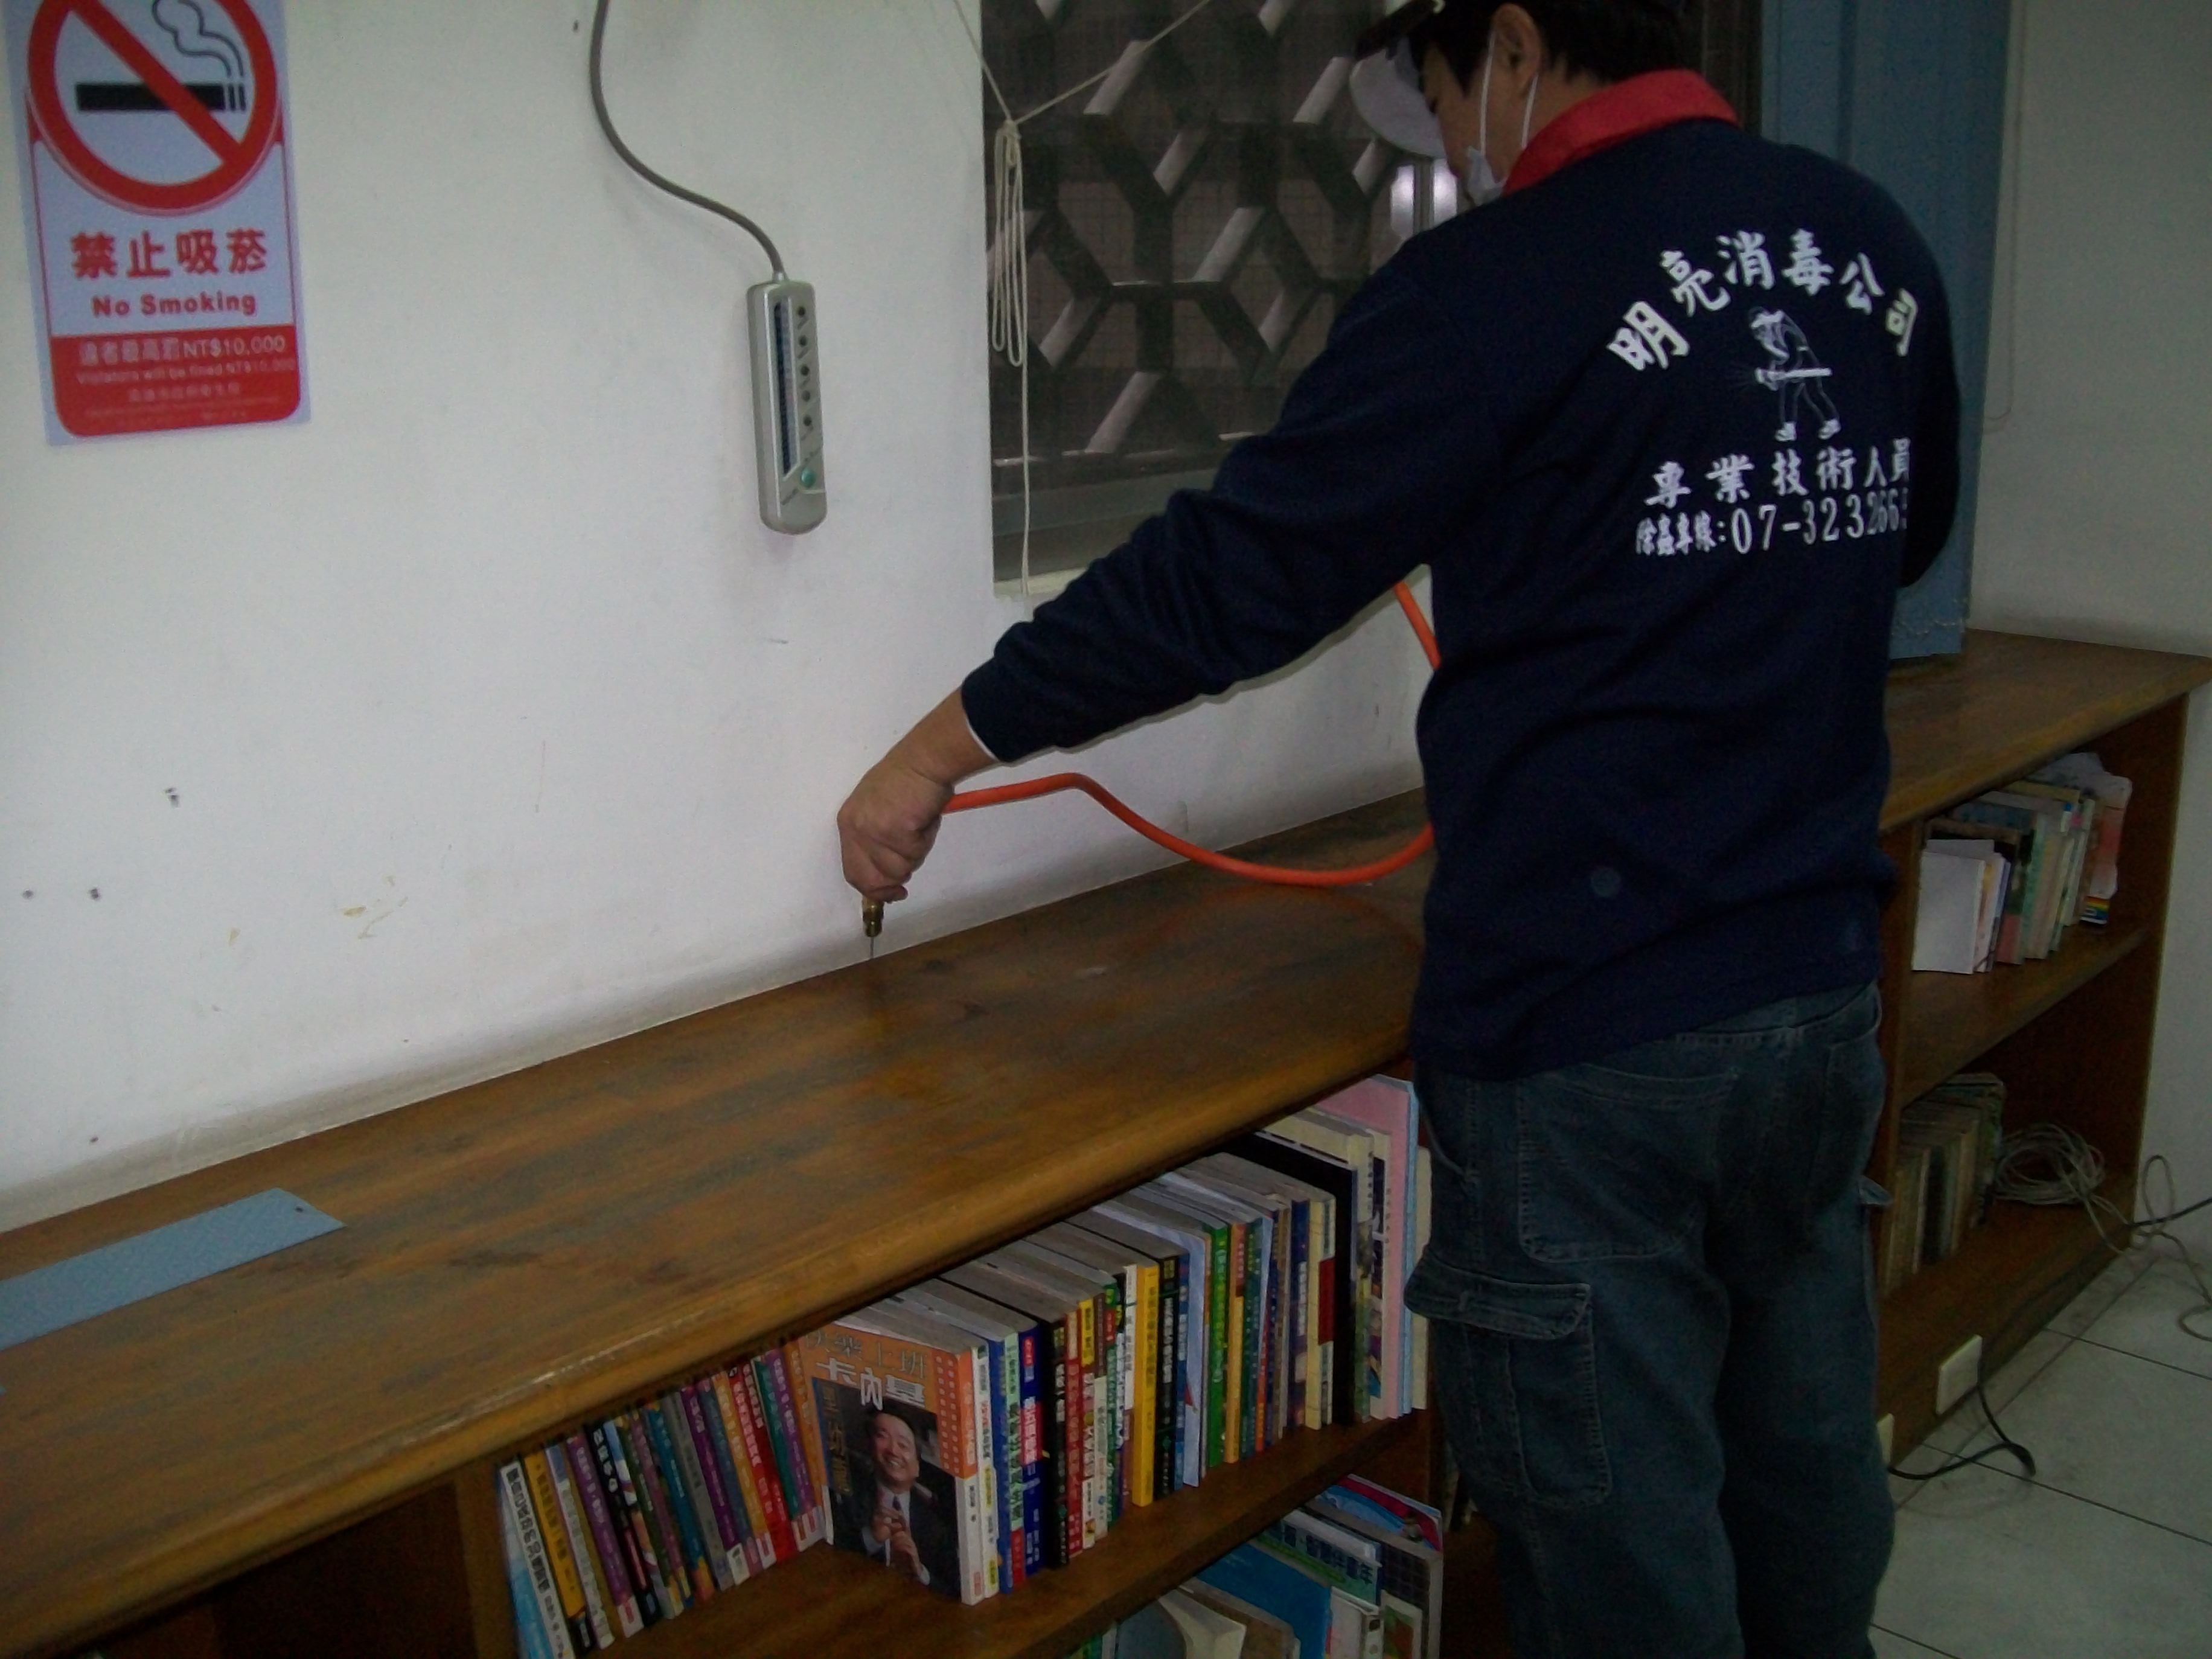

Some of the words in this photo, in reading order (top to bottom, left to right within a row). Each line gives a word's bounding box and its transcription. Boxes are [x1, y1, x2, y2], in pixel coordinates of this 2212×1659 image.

[71, 228, 267, 280] 禁止吸菸
[92, 295, 130, 317] No
[140, 290, 257, 316] Smoking
[1606, 228, 1919, 371] 明亮消毒公司
[1645, 437, 1911, 507] 專業技術人員
